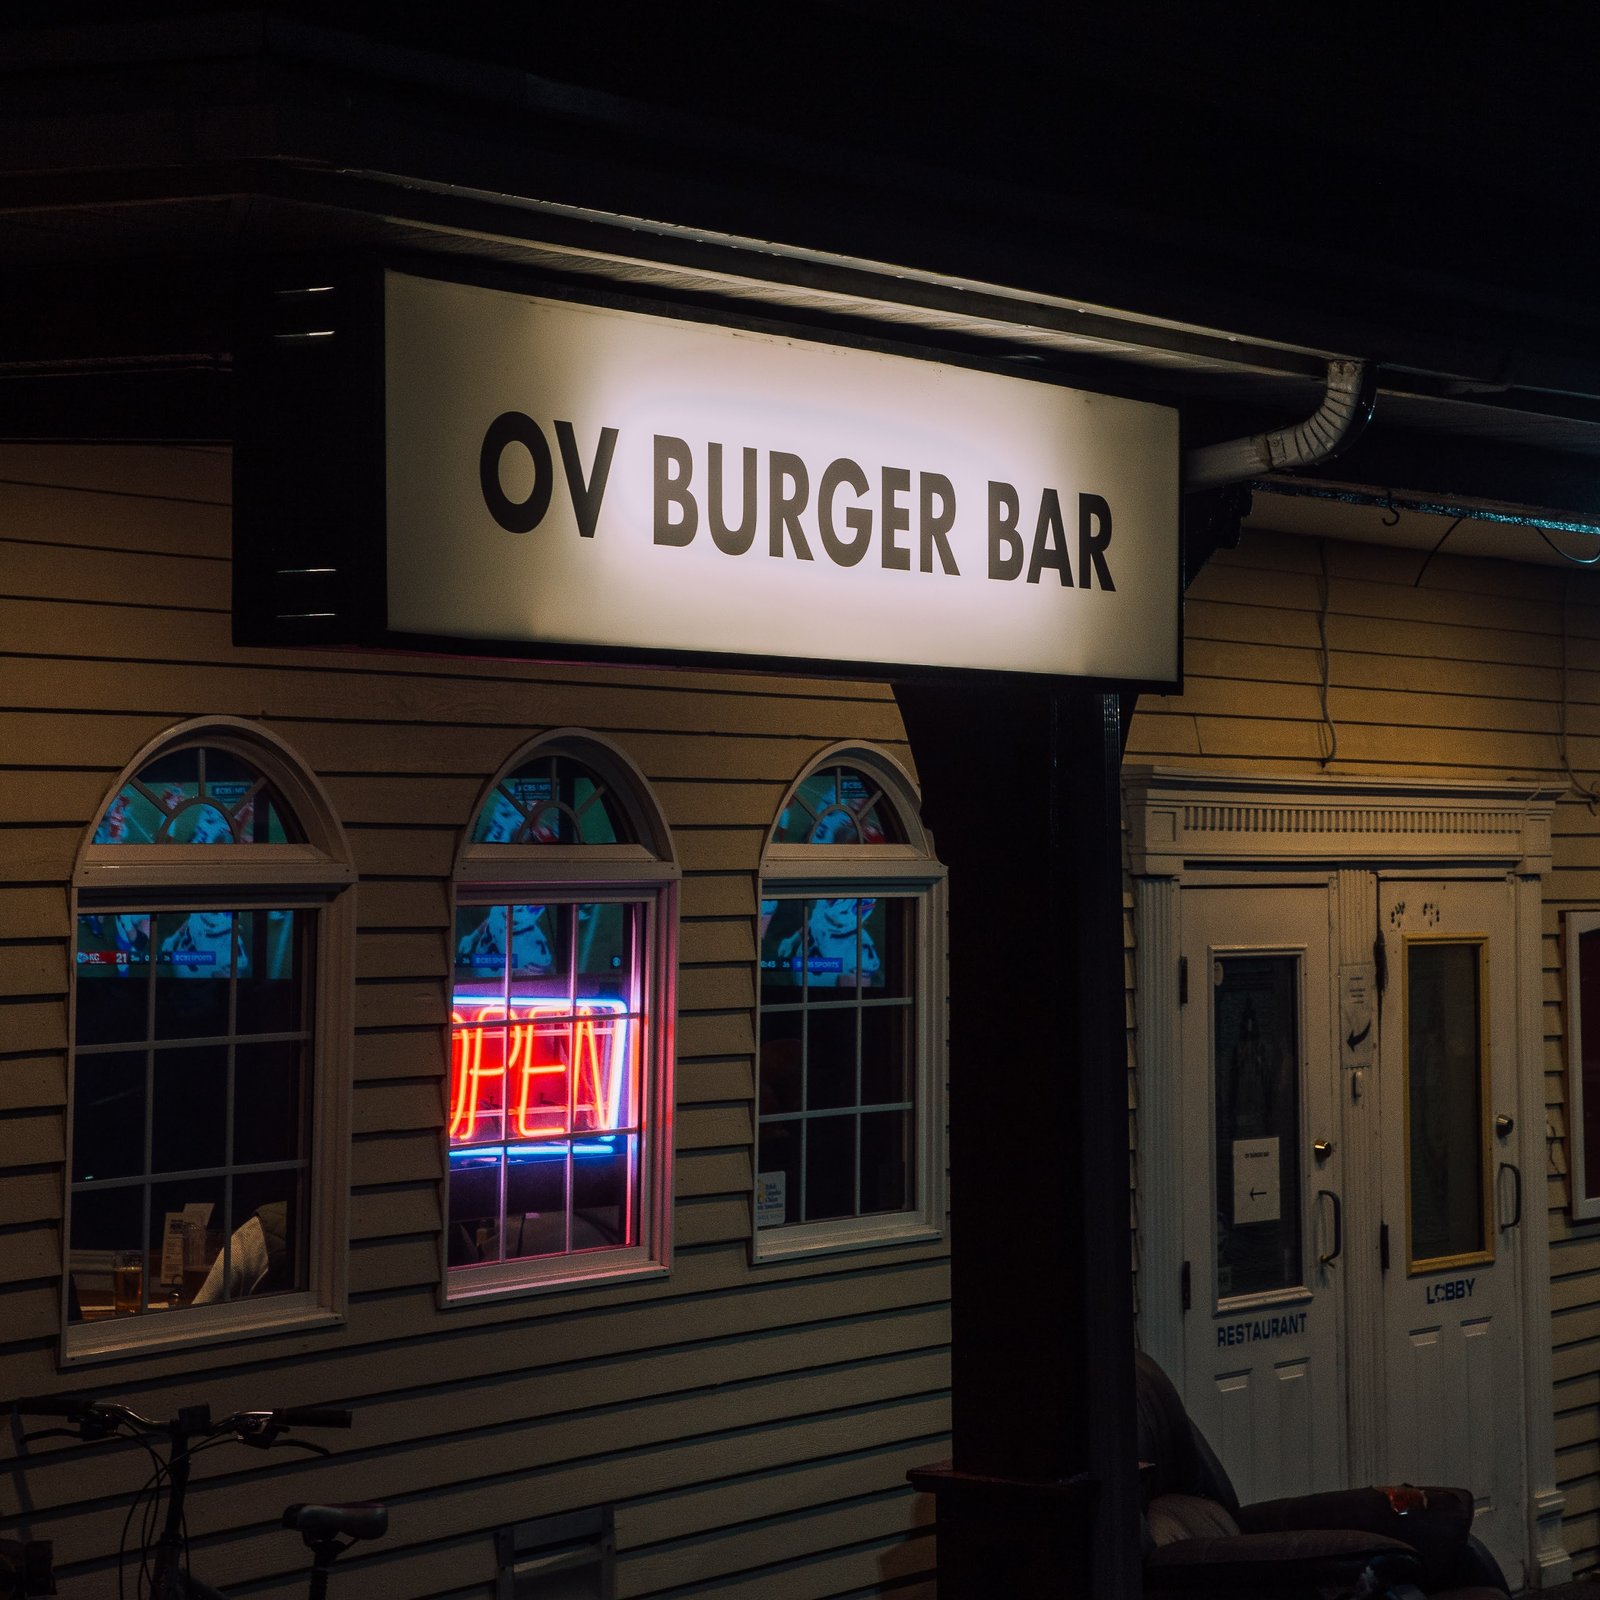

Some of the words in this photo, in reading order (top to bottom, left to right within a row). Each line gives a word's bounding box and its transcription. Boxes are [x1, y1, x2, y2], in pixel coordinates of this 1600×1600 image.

[479, 411, 620, 538] OV
[653, 434, 961, 576] BURGER
[988, 480, 1117, 592] BAR
[116, 952, 127, 963] 21
[1217, 1313, 1307, 1347] RESTAURANT
